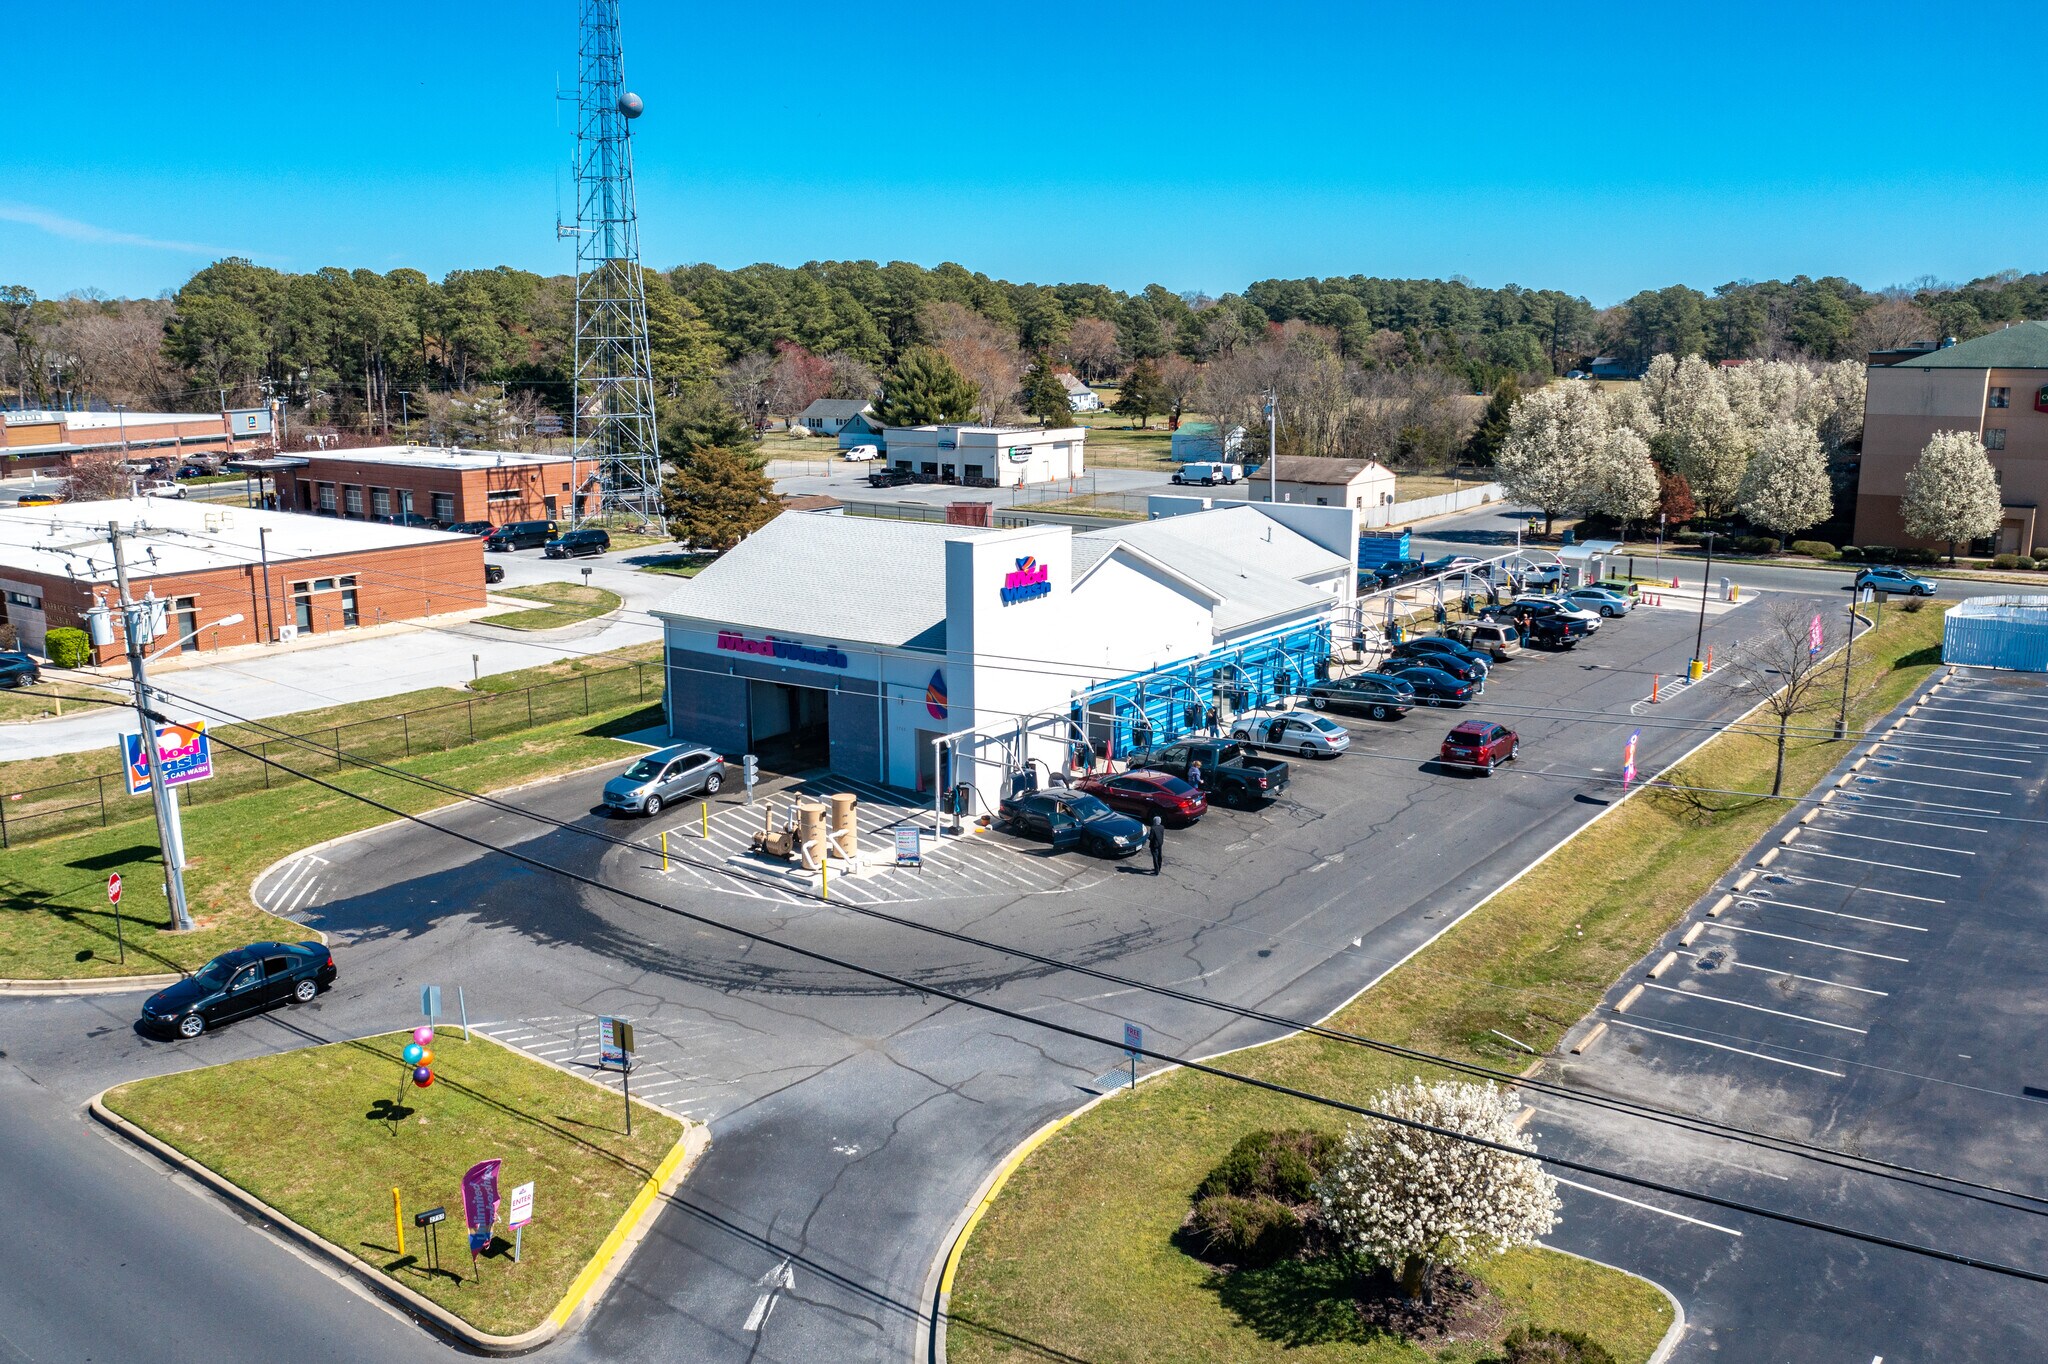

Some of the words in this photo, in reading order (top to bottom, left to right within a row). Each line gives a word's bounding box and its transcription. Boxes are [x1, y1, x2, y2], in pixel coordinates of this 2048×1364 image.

[1005, 564, 1048, 590] Mod
[1000, 580, 1052, 606] Wash
[170, 771, 186, 779] CAR
[187, 765, 208, 776] WASH
[109, 880, 121, 897] STOP
[513, 1194, 532, 1207] ENTER
